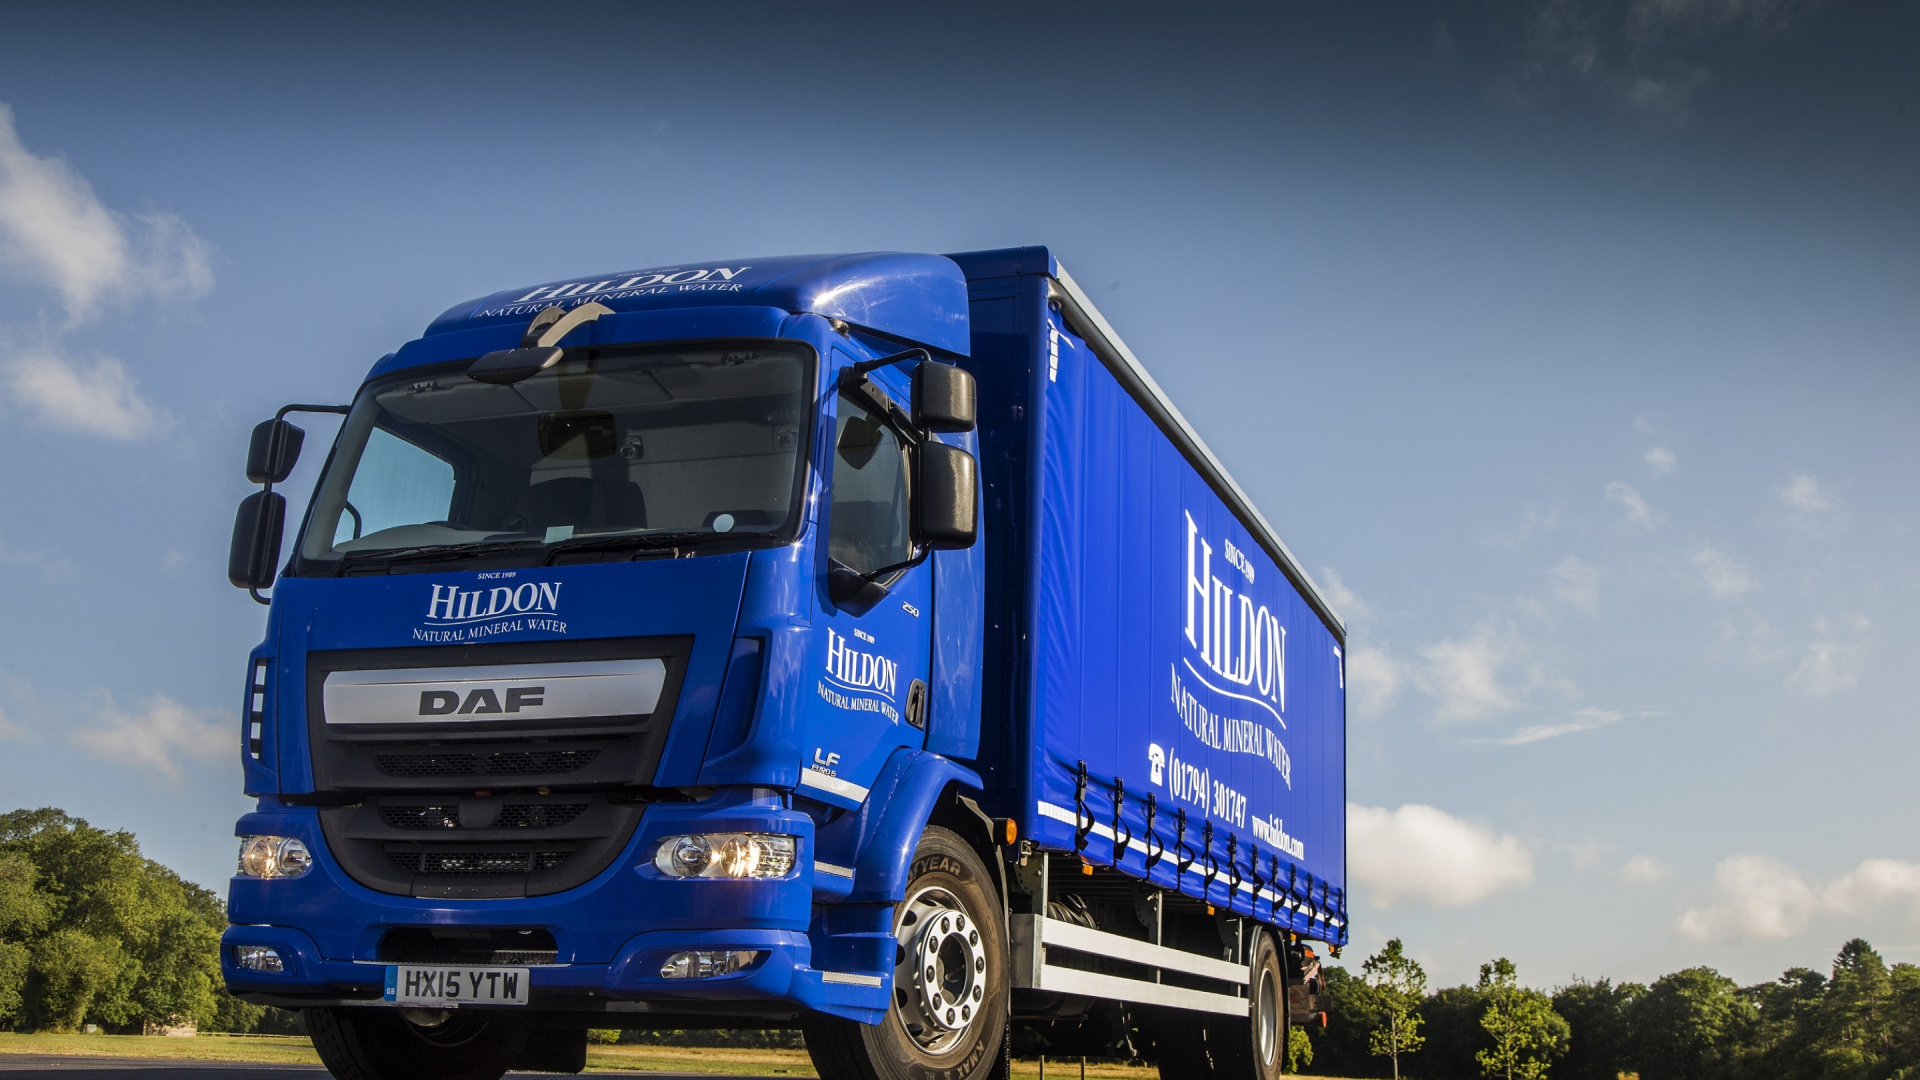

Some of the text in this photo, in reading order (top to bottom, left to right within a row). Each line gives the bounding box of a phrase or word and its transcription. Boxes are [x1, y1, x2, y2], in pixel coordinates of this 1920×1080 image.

[477, 282, 743, 317] NATURAL MINERAL WATER
[513, 267, 752, 303] HILDON
[1225, 538, 1246, 574] SINCE
[477, 571, 517, 580] SINCE 1989
[426, 582, 563, 620] HILDON
[902, 601, 920, 618] 250
[1185, 508, 1287, 713] HILDON
[412, 619, 567, 642] NATURAL MINERAL WATER
[853, 628, 867, 641] SINCE
[826, 627, 898, 697] HILDON
[419, 686, 545, 716] DAF
[817, 680, 900, 727] NATURAL MINERAL WATER
[1170, 662, 1292, 791] NATURAL MINERAL WATER
[814, 747, 841, 767] LF
[1168, 747, 1247, 830] (01794) 301747
[1251, 813, 1305, 861] www.hildon.com
[404, 970, 519, 999] HX15 YTW
